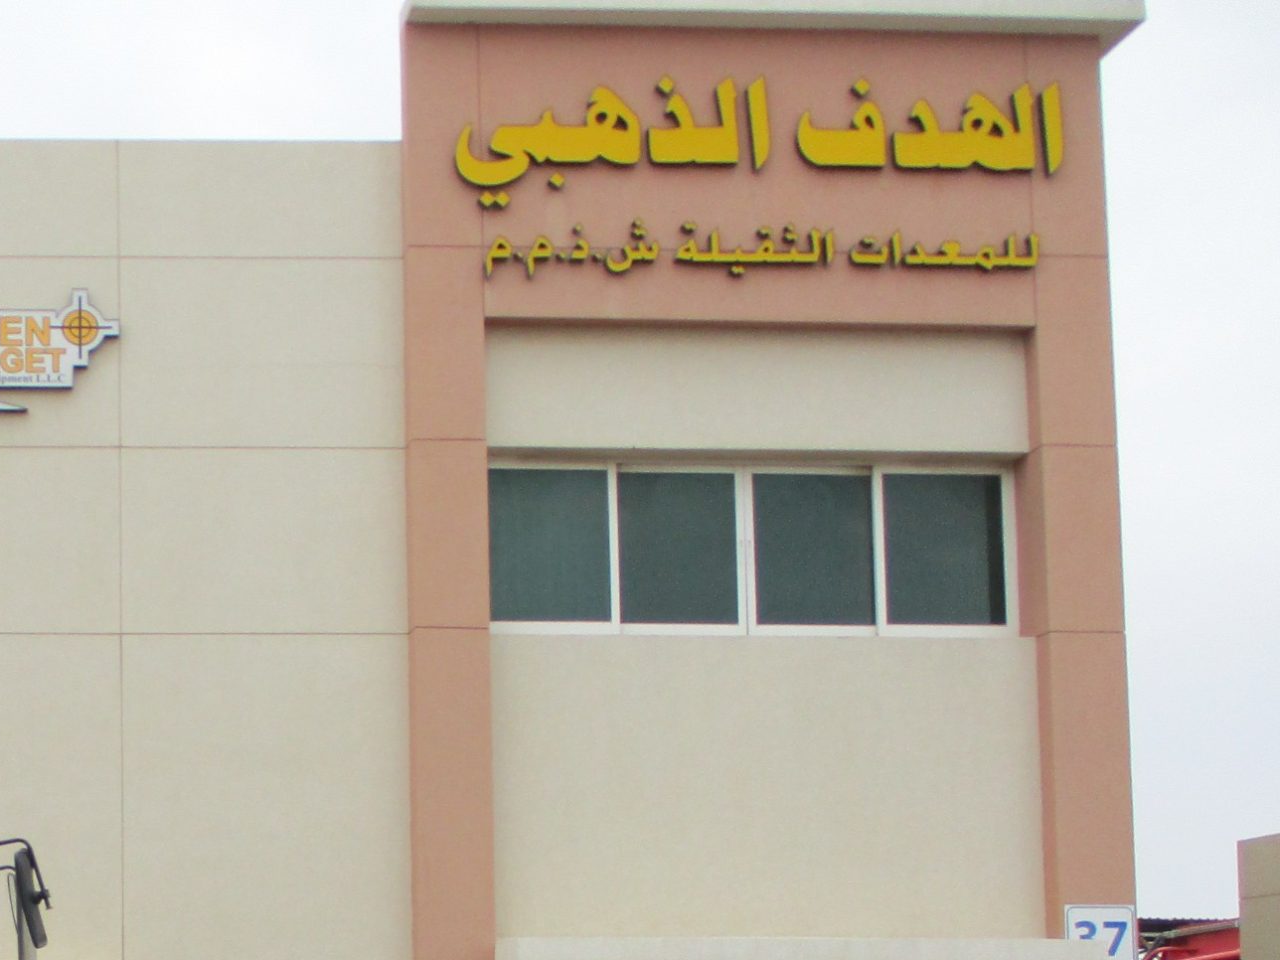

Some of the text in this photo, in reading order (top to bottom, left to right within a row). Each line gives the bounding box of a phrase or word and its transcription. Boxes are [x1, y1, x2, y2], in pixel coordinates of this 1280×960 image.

[453, 75, 1065, 208] الهدف الذهبي
[675, 222, 836, 275] الثقيلة
[849, 232, 1041, 271] للمعدات
